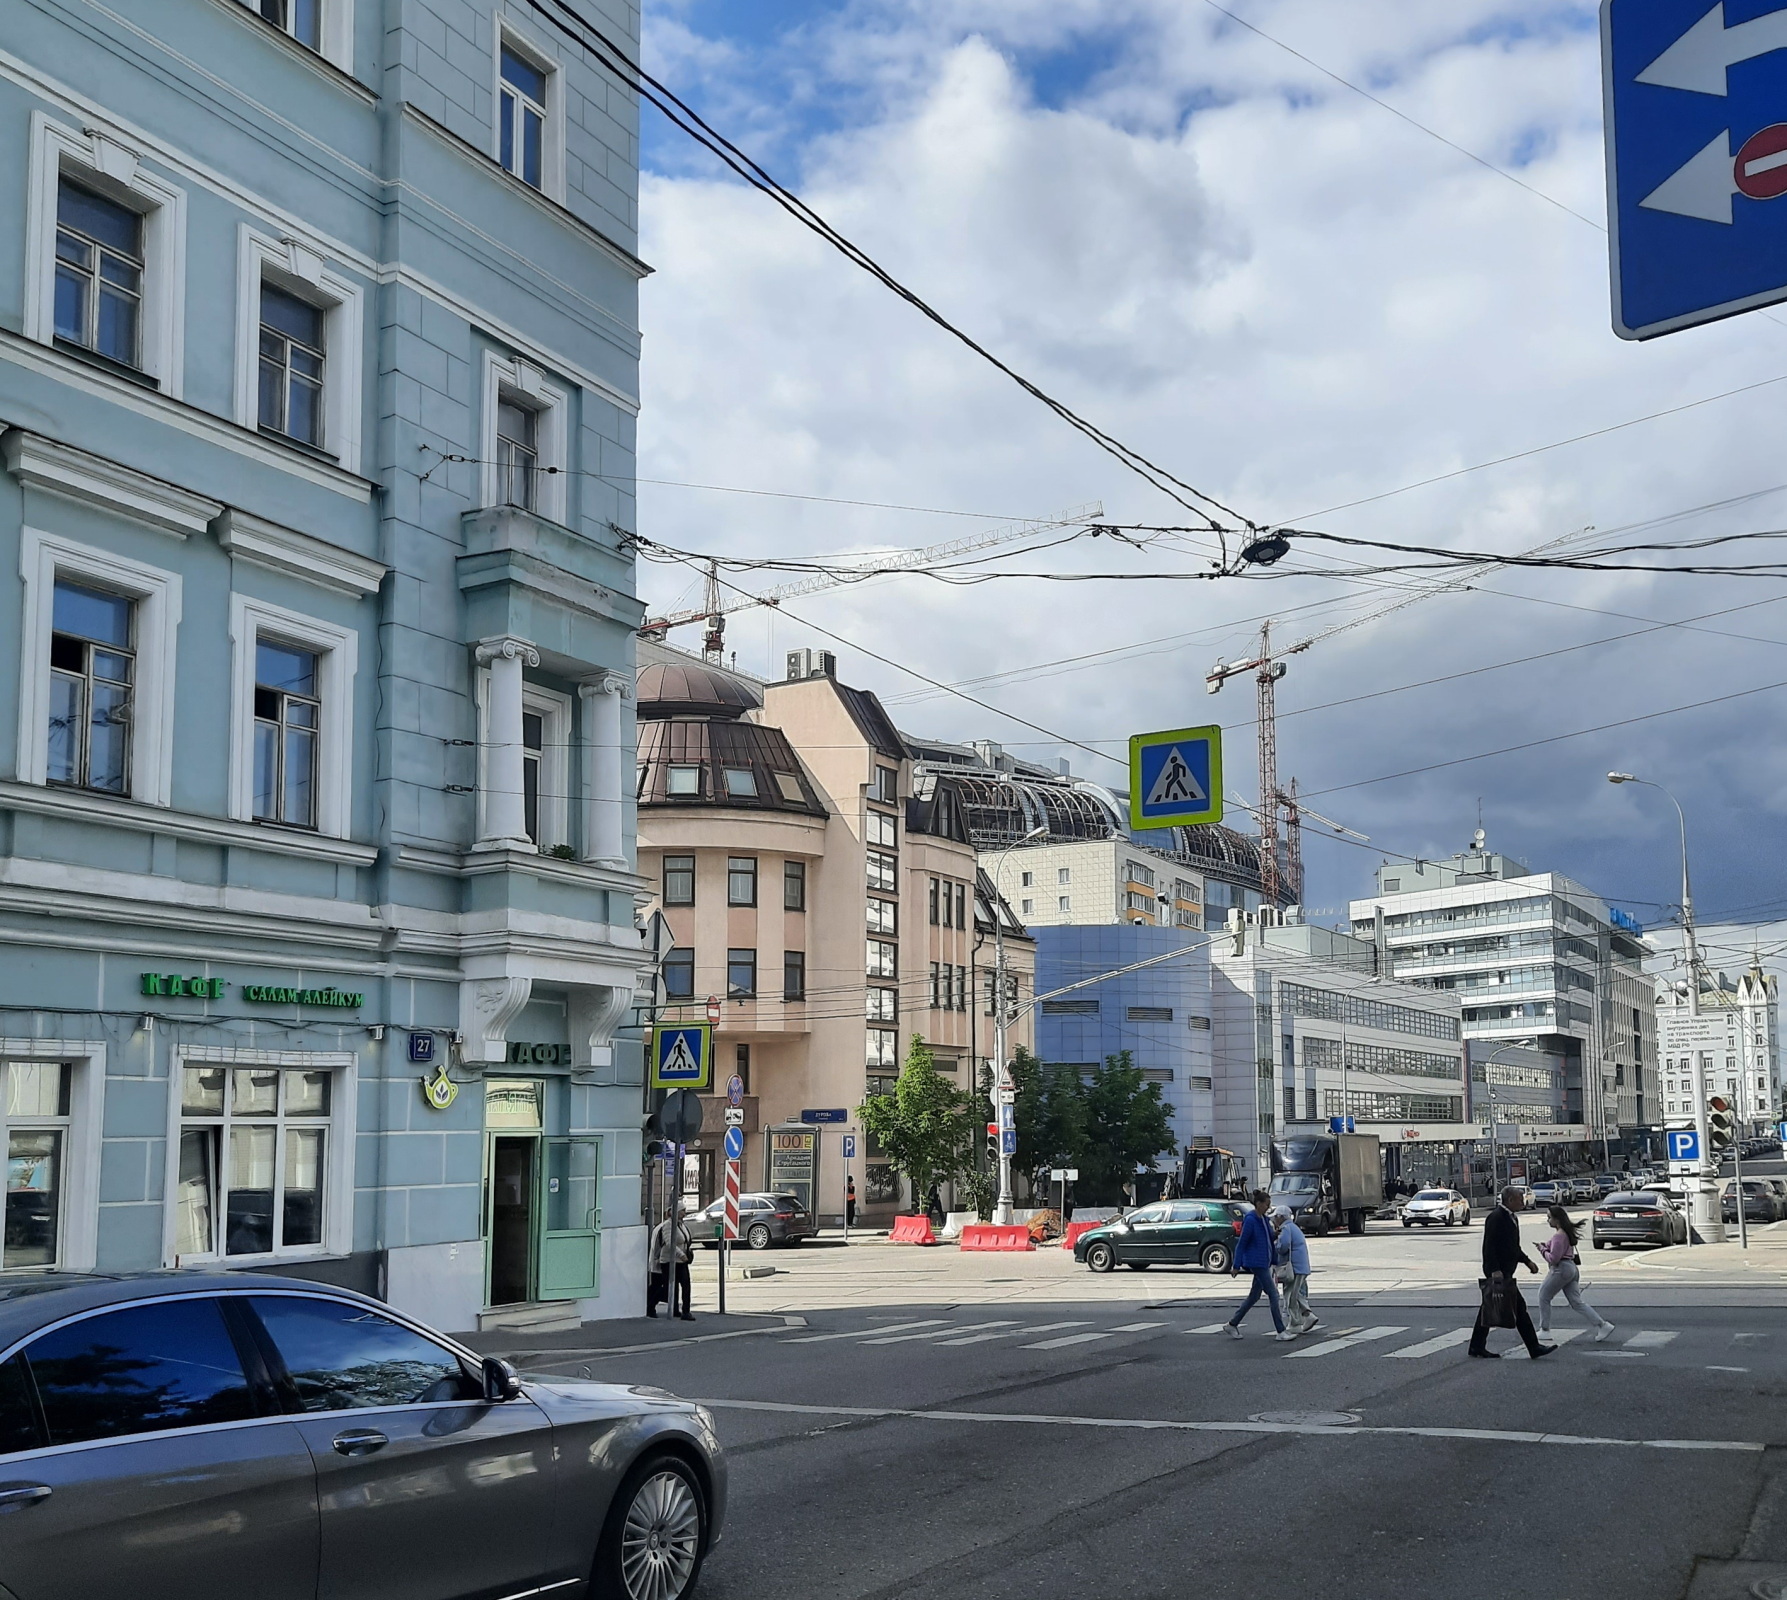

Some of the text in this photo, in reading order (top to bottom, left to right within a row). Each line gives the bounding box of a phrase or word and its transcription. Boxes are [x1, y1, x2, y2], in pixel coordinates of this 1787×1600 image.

[143, 973, 224, 999] КАФЕ
[247, 985, 365, 1008] САЛАМ АЛЕЙКУМ
[417, 1039, 430, 1053] 27
[776, 1134, 802, 1149] 100
[845, 1137, 854, 1156] P
[1675, 1134, 1694, 1158] P
